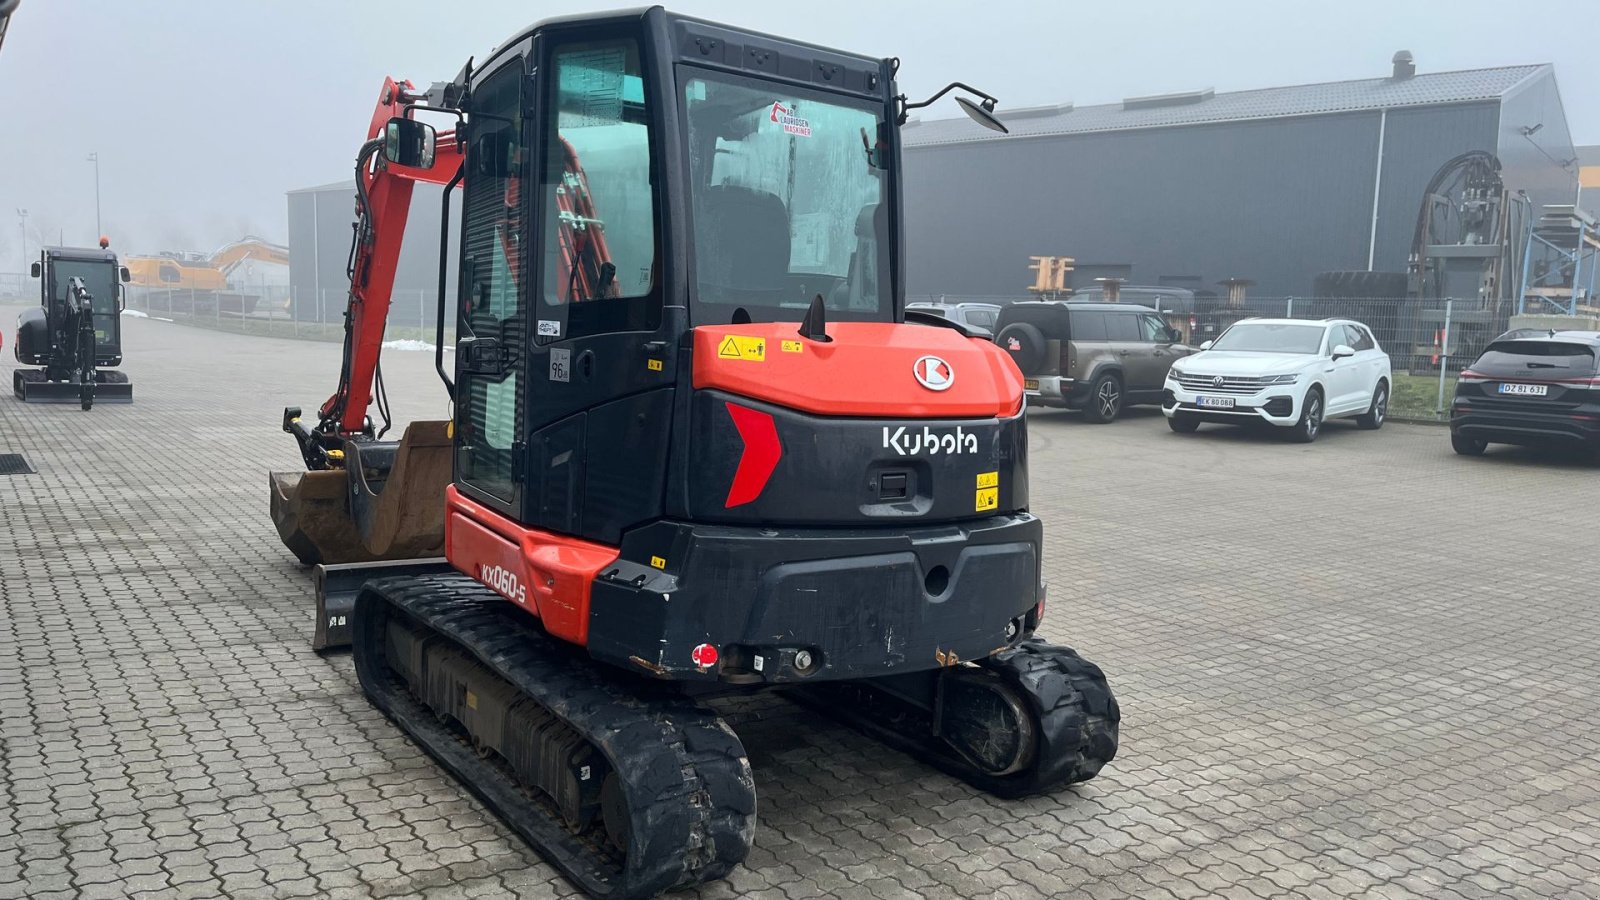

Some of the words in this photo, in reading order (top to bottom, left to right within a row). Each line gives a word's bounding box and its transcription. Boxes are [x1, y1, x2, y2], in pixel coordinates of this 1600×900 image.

[786, 108, 794, 117] AB
[784, 125, 811, 136] MASKINER
[552, 362, 563, 378] 96
[1504, 384, 1516, 392] DZ
[1517, 385, 1527, 393] 81
[1529, 385, 1544, 394] 631
[882, 425, 978, 456] Kubota
[482, 563, 526, 604] KX060-5
